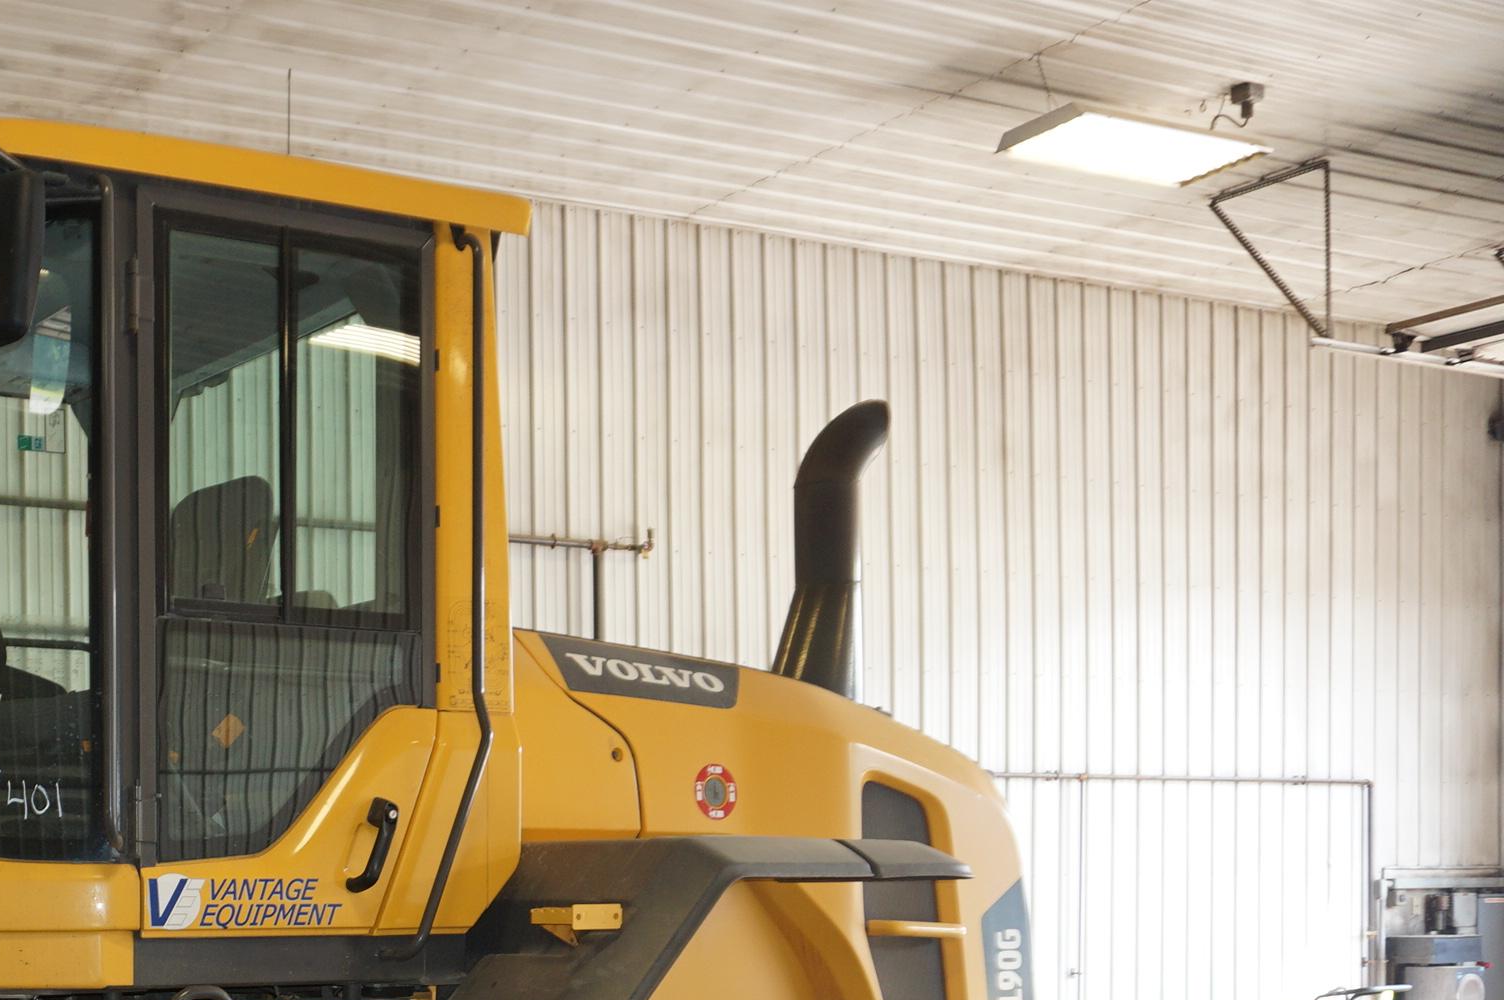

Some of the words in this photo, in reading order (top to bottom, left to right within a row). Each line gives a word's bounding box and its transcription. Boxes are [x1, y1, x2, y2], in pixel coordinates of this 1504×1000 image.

[565, 652, 725, 693] VOLVO
[210, 878, 319, 900] VANTAGE
[199, 903, 343, 929] EQUIPMENT
